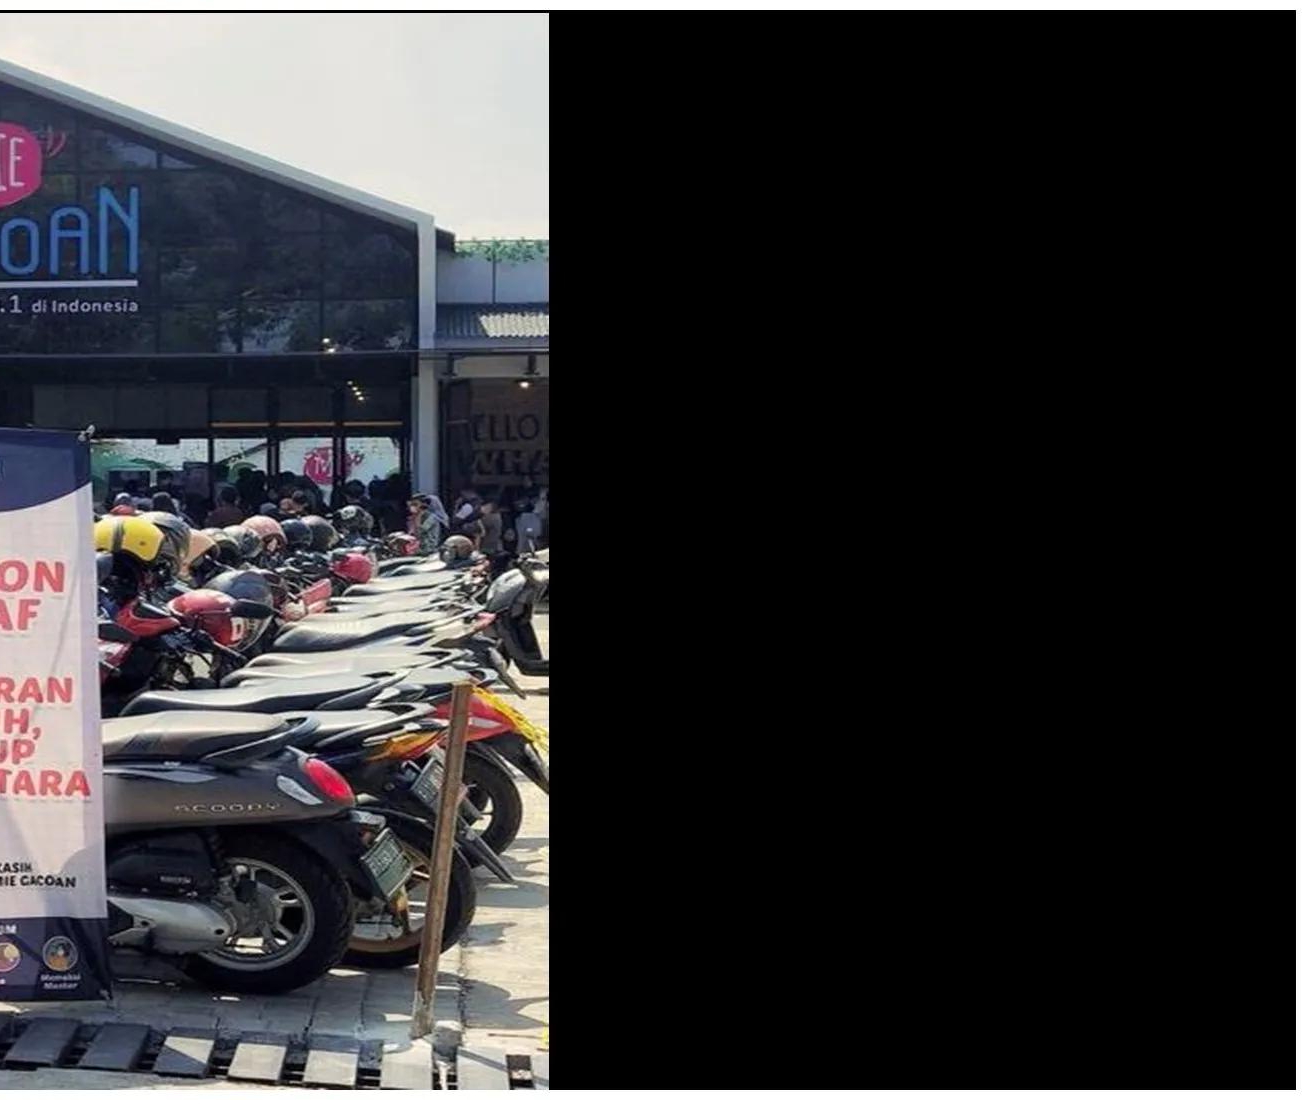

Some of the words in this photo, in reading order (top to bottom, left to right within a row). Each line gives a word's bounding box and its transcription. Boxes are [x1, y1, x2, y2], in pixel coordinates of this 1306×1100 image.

[32, 299, 48, 313] di
[52, 299, 139, 313] Indonesia
[20, 874, 77, 888] GACOAN
